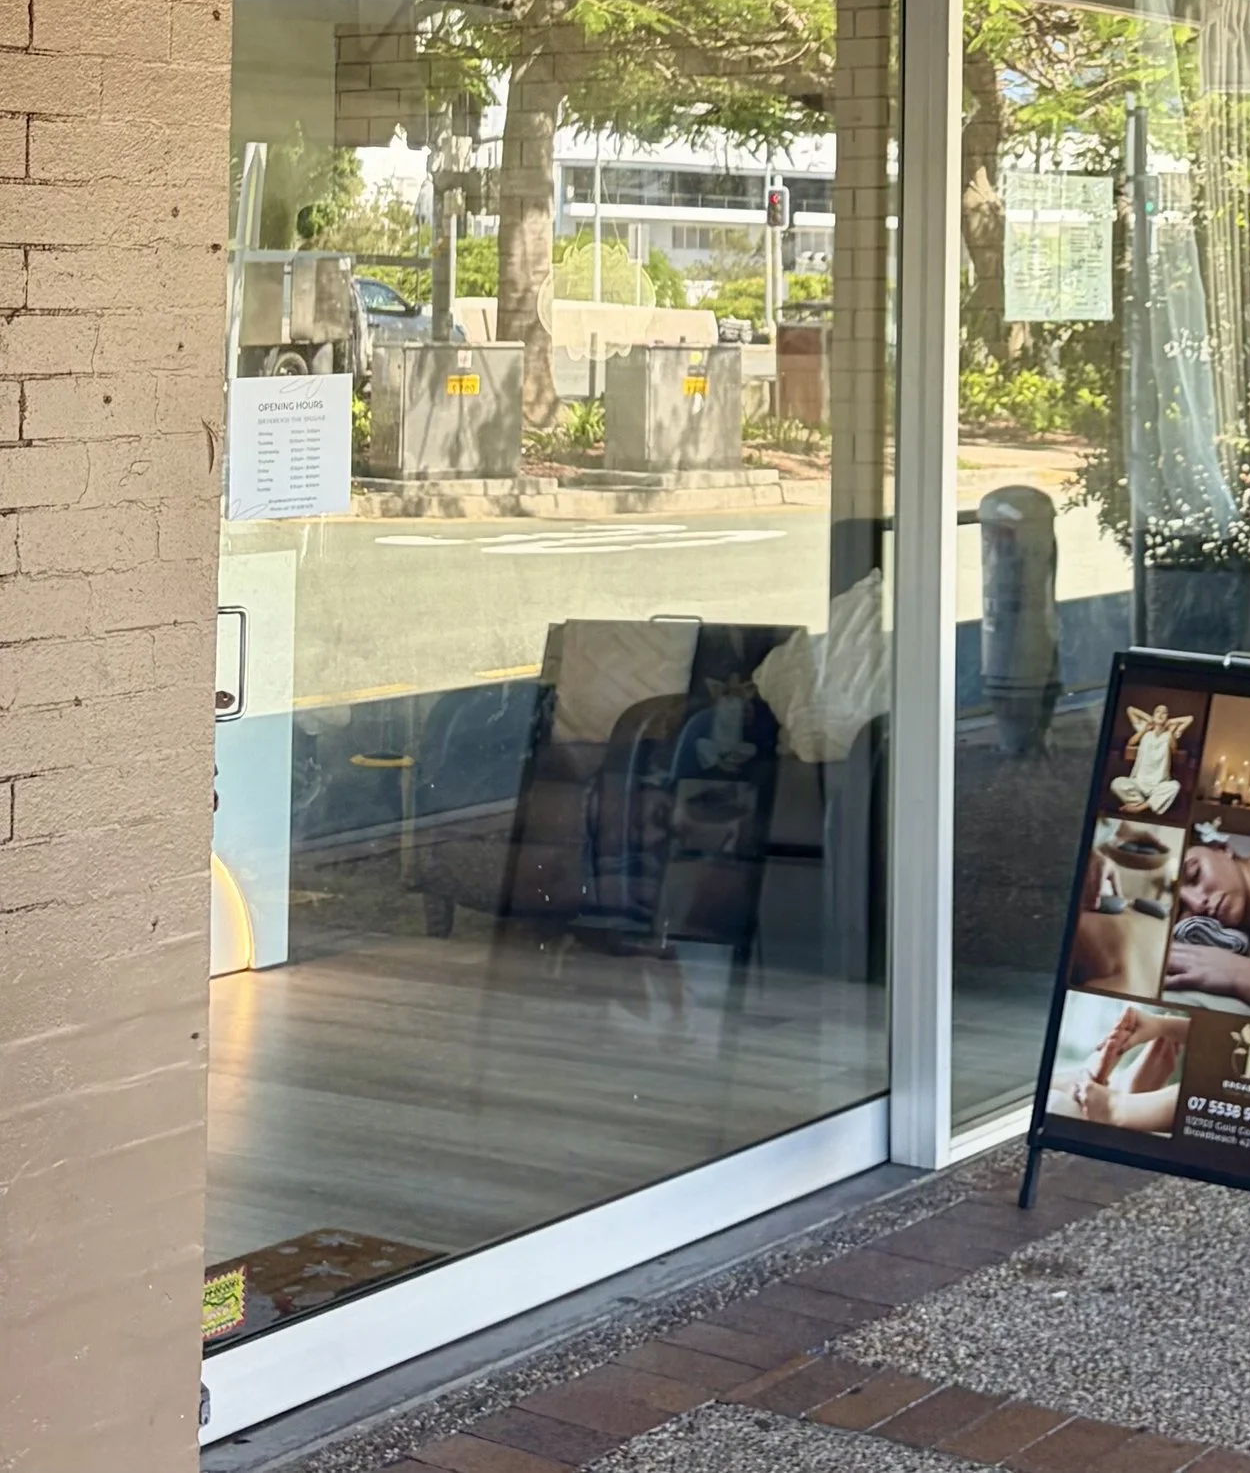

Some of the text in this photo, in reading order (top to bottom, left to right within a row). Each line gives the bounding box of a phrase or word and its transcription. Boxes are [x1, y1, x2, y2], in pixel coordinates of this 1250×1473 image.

[258, 400, 324, 413] OPENING HOURS
[1187, 1095, 1207, 1112] 07
[1208, 1099, 1242, 1119] 5538
